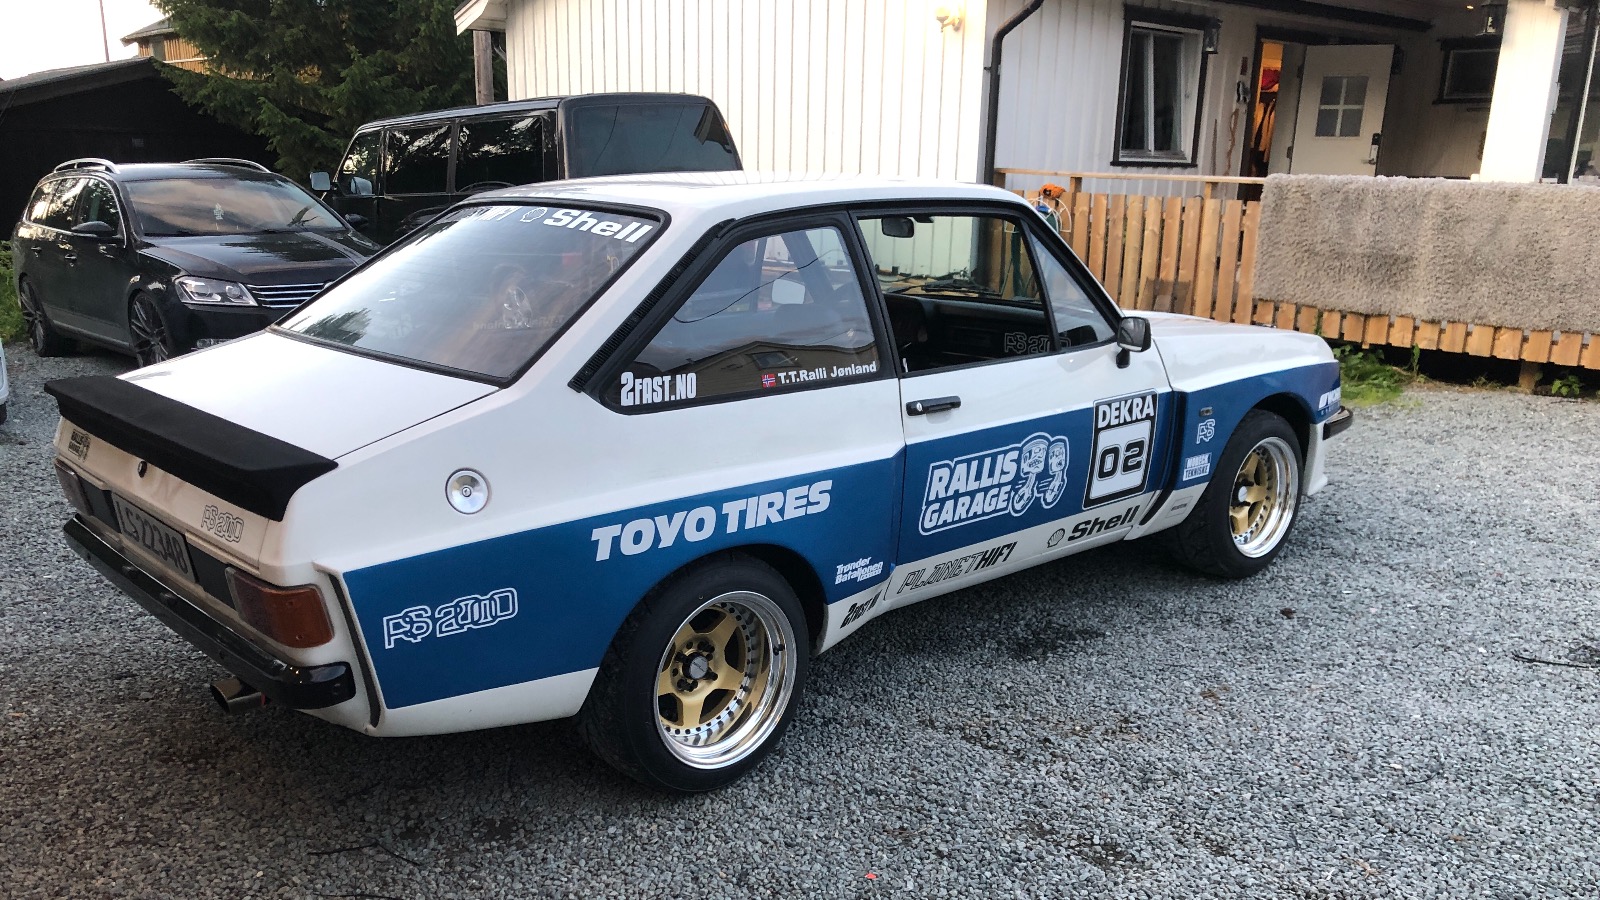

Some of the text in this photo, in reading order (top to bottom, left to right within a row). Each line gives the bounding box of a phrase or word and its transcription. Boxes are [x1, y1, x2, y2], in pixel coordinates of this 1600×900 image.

[543, 209, 653, 243] Shell
[830, 361, 877, 378] Jønland
[620, 371, 697, 406] 2FAST.NO
[1098, 395, 1155, 428] DEKRA
[1196, 419, 1215, 444] RS
[929, 450, 1020, 501] RALLIS
[1099, 440, 1145, 479] 02
[591, 480, 833, 562] TOYO TIRES
[923, 485, 1012, 528] GARAGE
[1067, 505, 1140, 541] Shell
[383, 587, 518, 649] RS 2000
